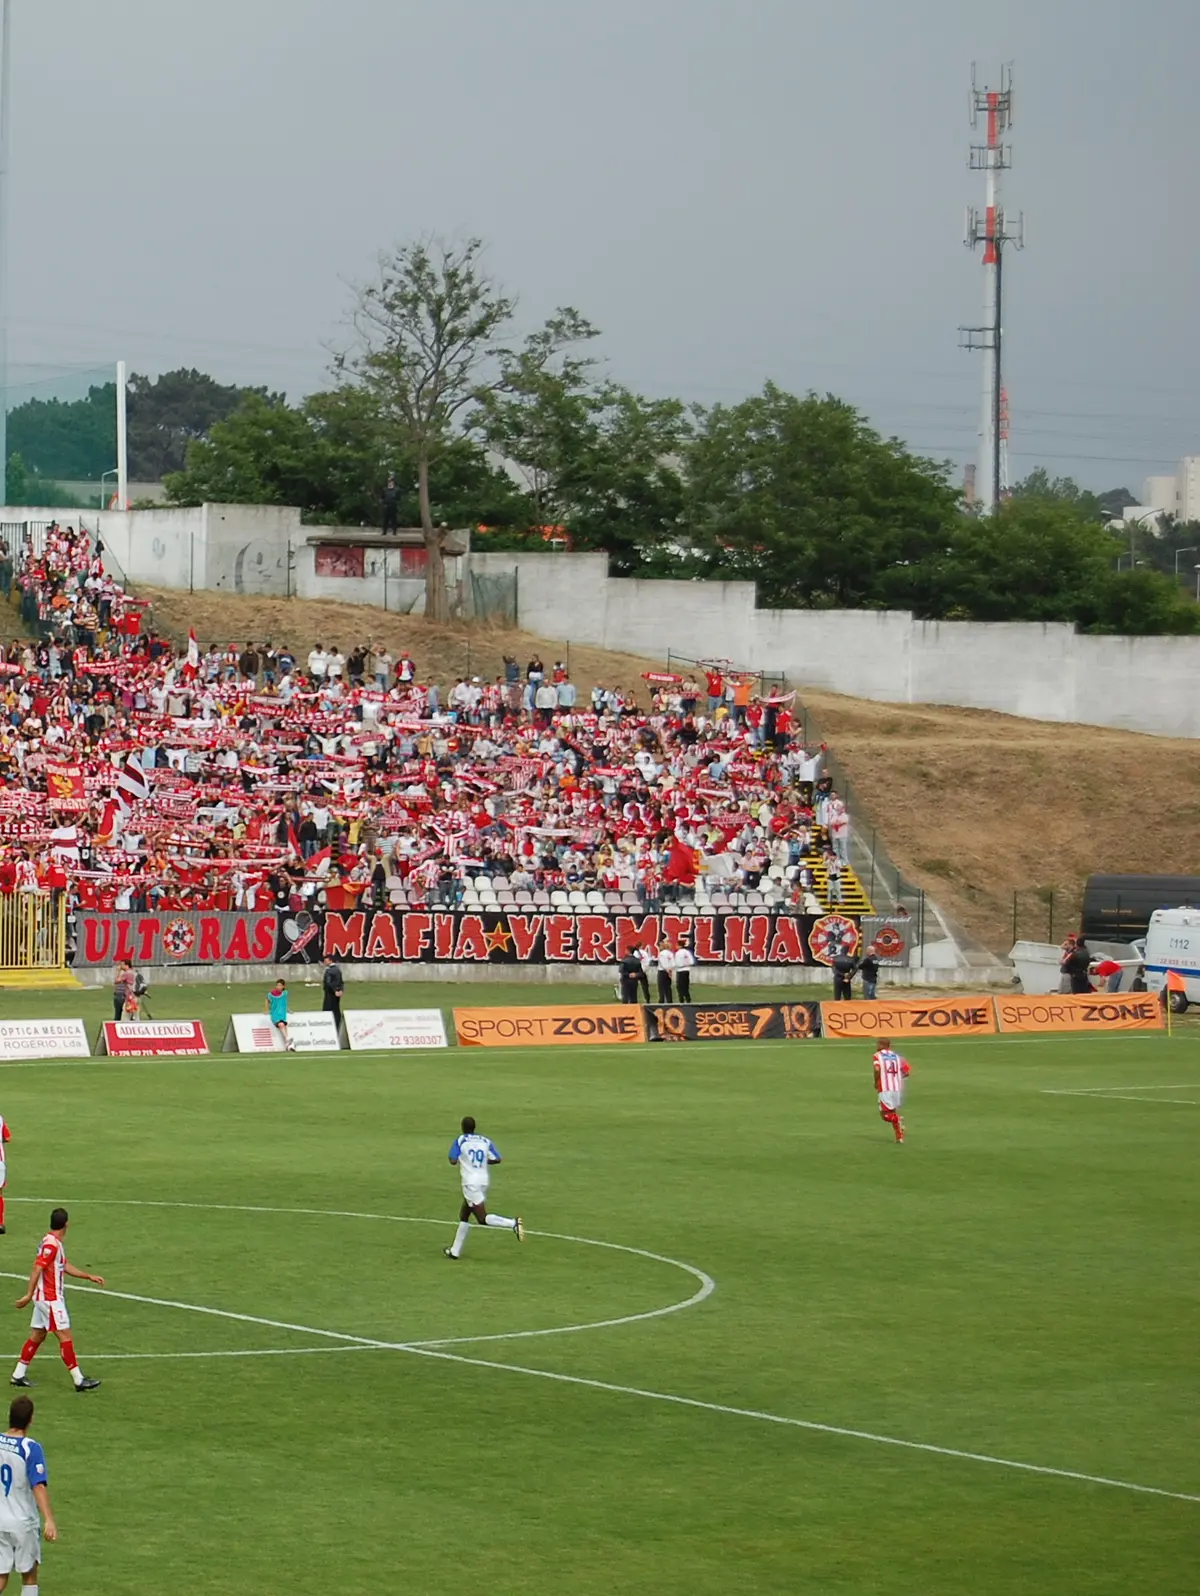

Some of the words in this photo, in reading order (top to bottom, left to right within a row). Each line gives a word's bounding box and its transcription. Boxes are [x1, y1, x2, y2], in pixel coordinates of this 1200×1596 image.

[324, 911, 490, 960] MAFIA
[507, 912, 803, 963] VERMELHA
[1174, 939, 1190, 950] 112
[695, 1011, 748, 1024] SPORT
[780, 1005, 809, 1031] 10
[828, 1011, 906, 1030] SPORT
[911, 1008, 988, 1027] ZONE
[1003, 1005, 1080, 1023] SPORT
[1081, 1003, 1155, 1021] ZONE
[120, 1026, 150, 1036] ADEGA
[152, 1024, 192, 1035] LEIXÕES
[462, 1019, 548, 1038] SPORT
[553, 1017, 637, 1035] ZONE
[696, 1024, 750, 1036] ZONE
[389, 1036, 400, 1045] 22
